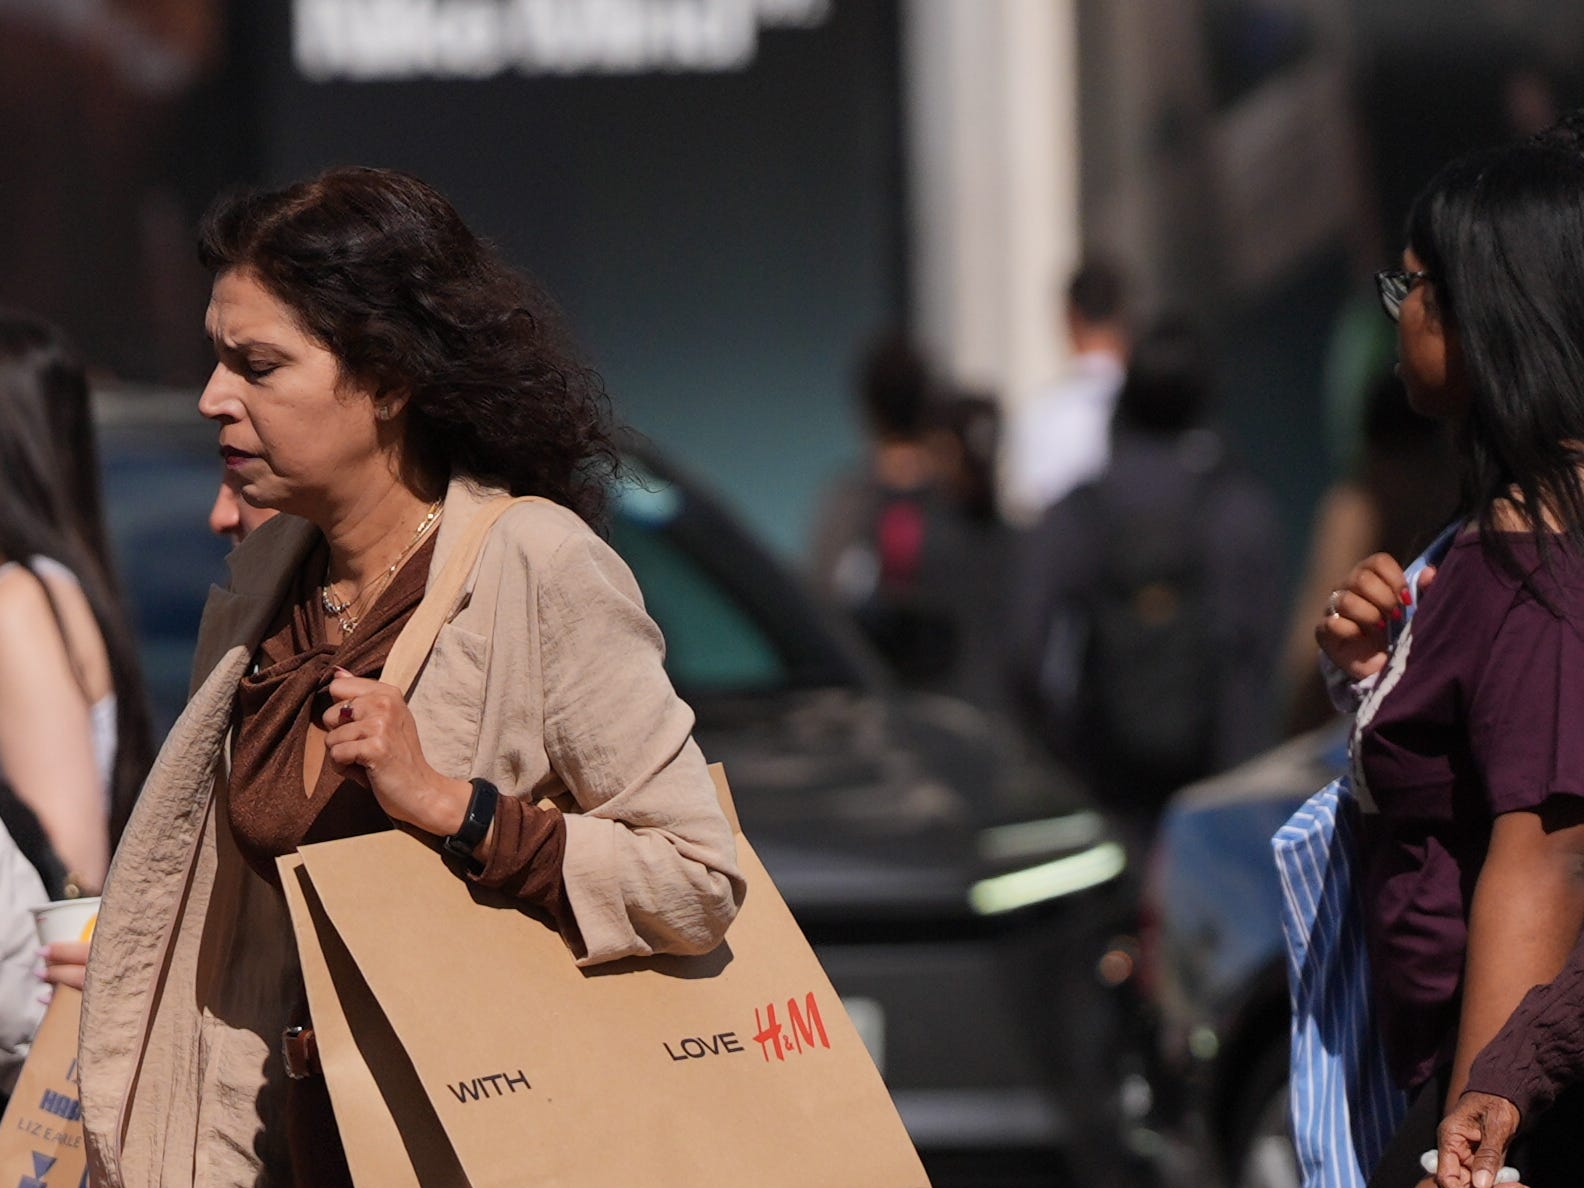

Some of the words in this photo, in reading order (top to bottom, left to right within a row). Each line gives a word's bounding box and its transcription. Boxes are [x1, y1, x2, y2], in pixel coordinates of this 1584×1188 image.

[447, 1069, 532, 1104] WITH
[663, 1031, 744, 1062] LOVE
[752, 991, 831, 1063] H&M
